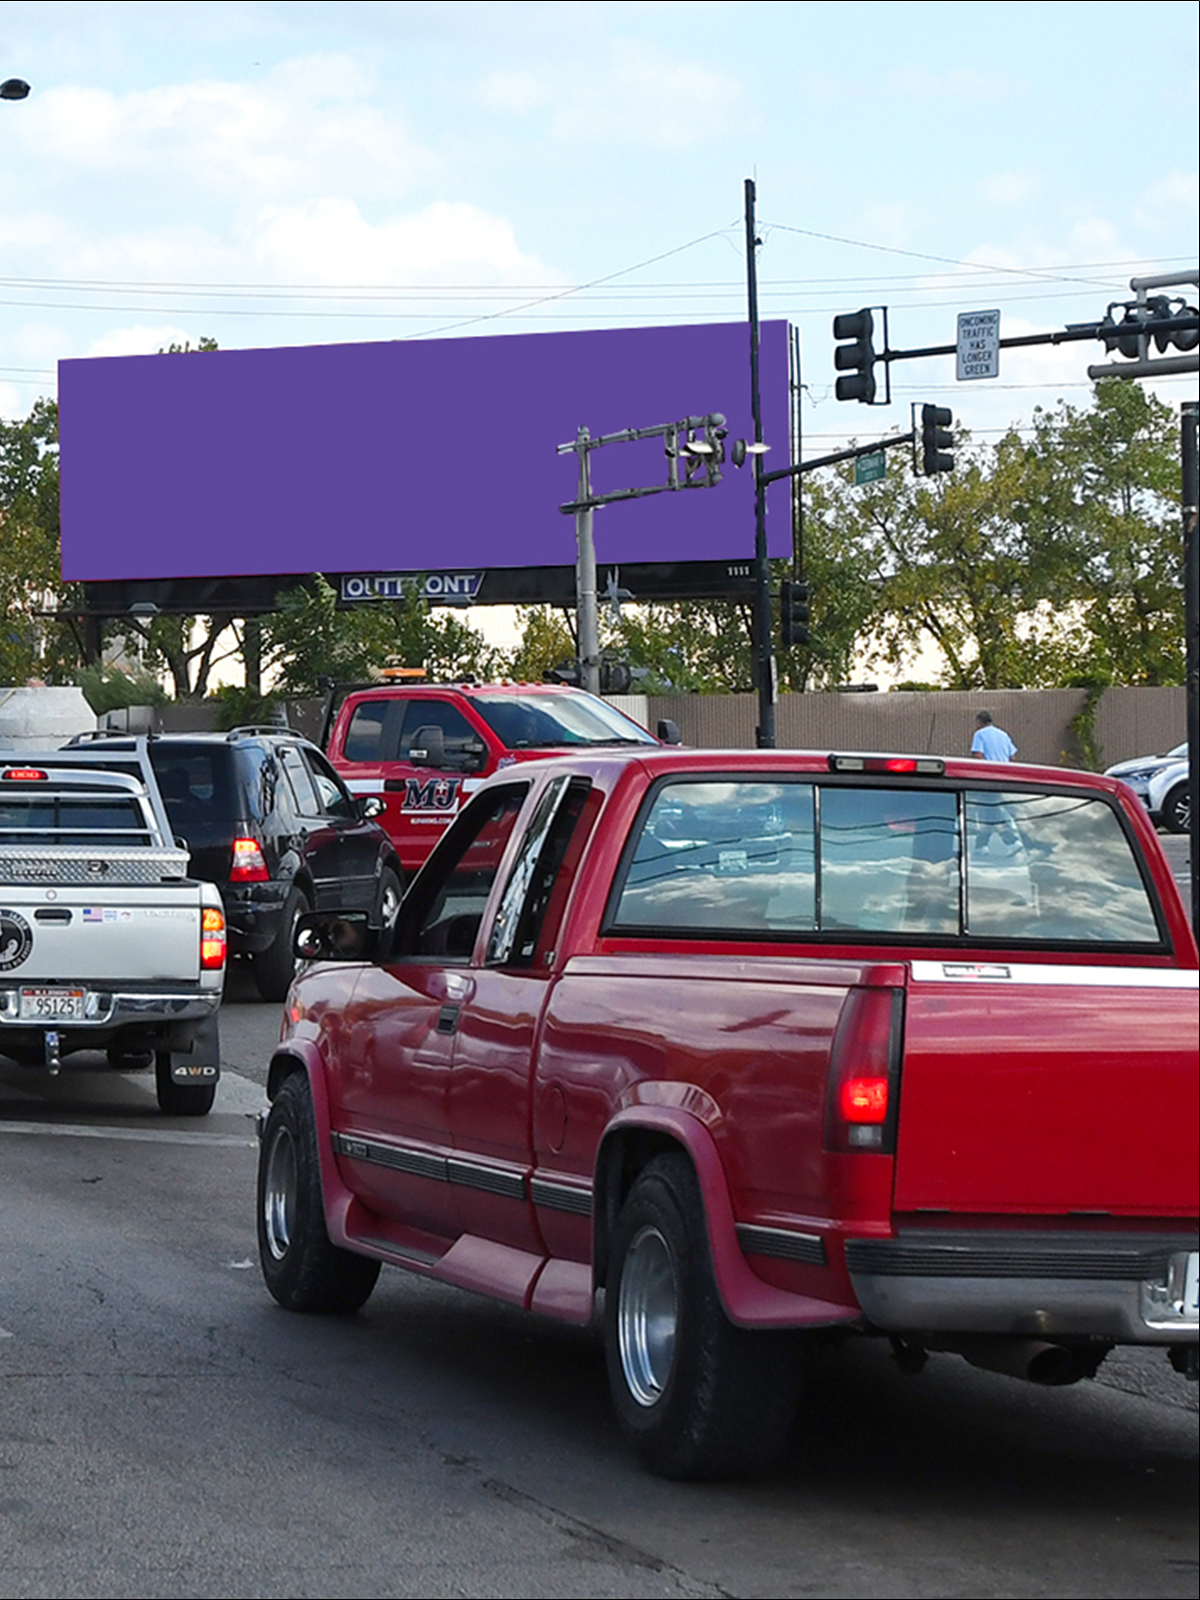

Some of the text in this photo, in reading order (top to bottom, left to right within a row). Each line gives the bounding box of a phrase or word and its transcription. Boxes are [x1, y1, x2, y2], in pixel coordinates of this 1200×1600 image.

[960, 314, 997, 328] ONCOMING
[962, 326, 994, 339] TRAFFIC
[969, 339, 987, 350] HAS
[961, 350, 992, 364] LONGER
[964, 363, 990, 375] GREEN
[36, 998, 75, 1016] 95125
[174, 1066, 216, 1076] 4WD
